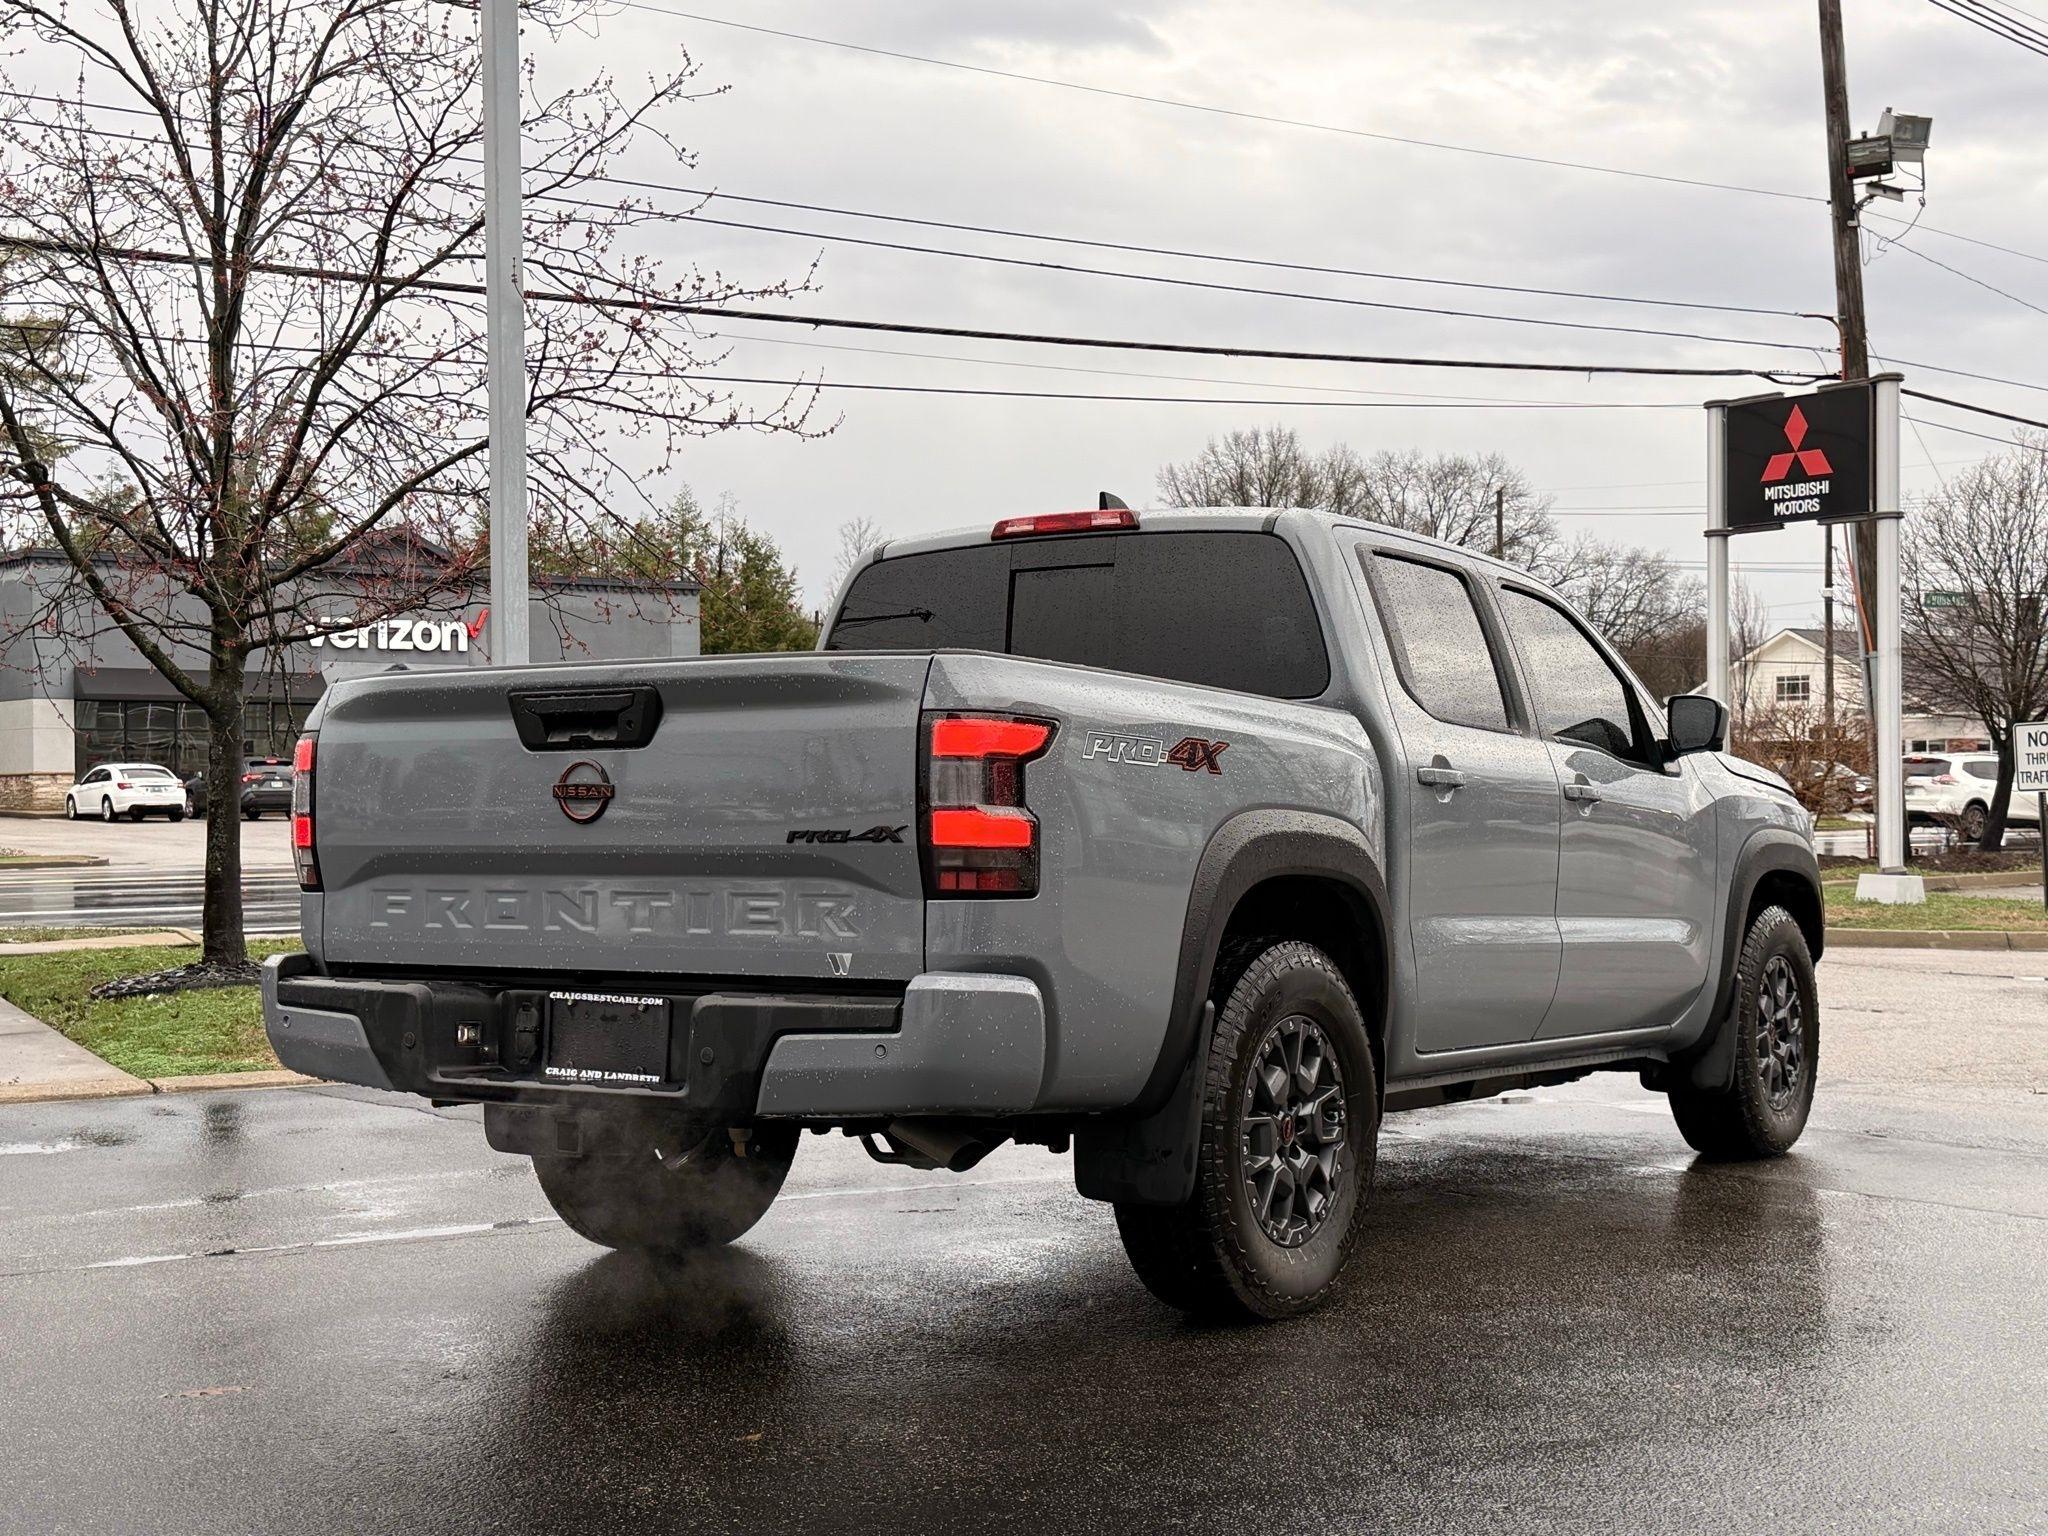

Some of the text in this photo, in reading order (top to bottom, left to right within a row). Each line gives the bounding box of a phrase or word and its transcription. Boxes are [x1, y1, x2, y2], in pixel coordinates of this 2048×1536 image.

[1764, 480, 1830, 500] MITSUBISHI
[1773, 498, 1820, 516] MOTORS
[303, 614, 469, 652] verizon
[2027, 731, 2048, 747] NO
[1082, 731, 1230, 775] PRO-4X
[2025, 752, 2048, 765] THR
[553, 786, 612, 797] NISSAN
[370, 888, 862, 938] FRONTIER
[549, 991, 663, 1006] CRAIGSBESTCARS.COM
[545, 1067, 578, 1077] CRAIG
[579, 1069, 603, 1079] AND
[603, 1071, 660, 1083] LANDRETH
